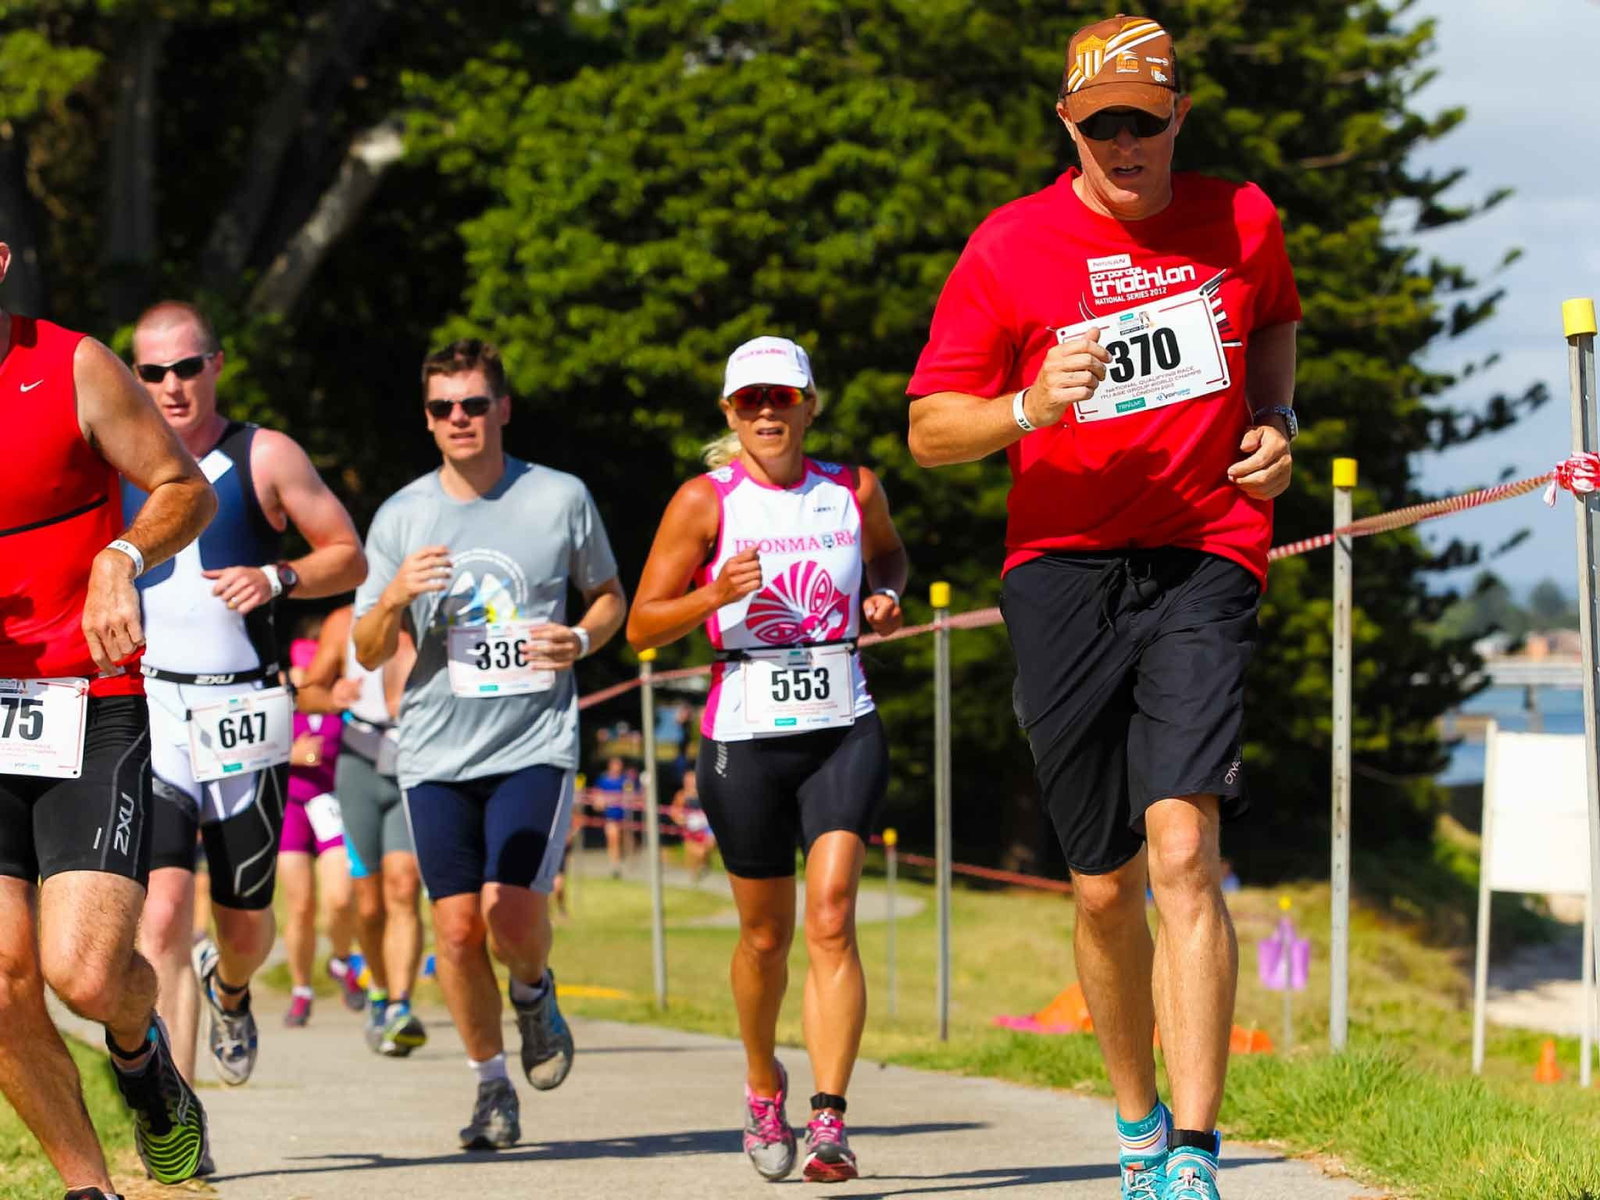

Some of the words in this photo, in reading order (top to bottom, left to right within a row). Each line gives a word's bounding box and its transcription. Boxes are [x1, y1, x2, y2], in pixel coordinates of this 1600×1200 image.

[1090, 264, 1196, 298] triathlon
[1094, 294, 1126, 306] NATIONAL
[1126, 290, 1150, 301] SERIES
[1149, 287, 1167, 296] 2012
[1106, 327, 1182, 384] 370
[771, 667, 830, 702] 553
[0, 697, 44, 741] 75
[218, 711, 267, 749] 647
[113, 792, 135, 856] 2XU
